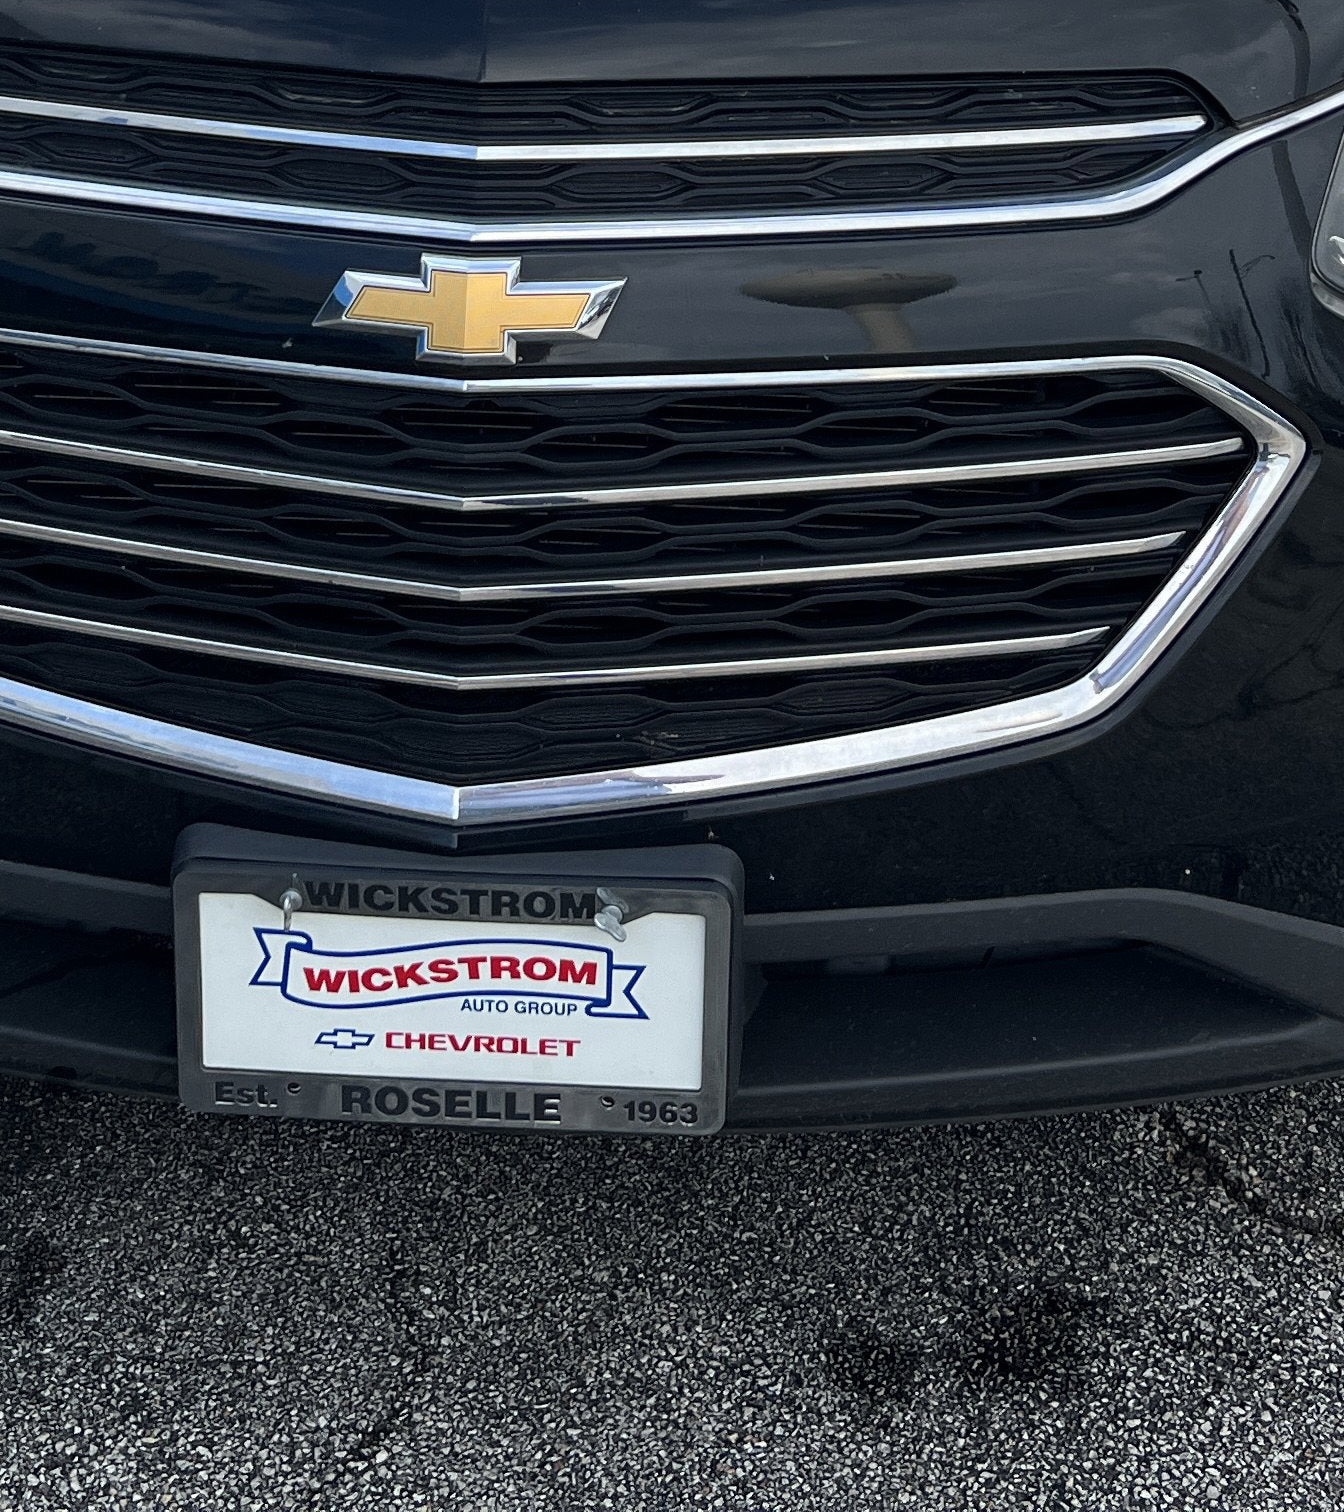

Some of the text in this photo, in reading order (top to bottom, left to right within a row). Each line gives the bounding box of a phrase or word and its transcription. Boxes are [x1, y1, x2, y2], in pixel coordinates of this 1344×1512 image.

[304, 881, 596, 920] WICKSTROM
[303, 955, 598, 994] WICKSTROM
[460, 998, 578, 1016] AUTO GROUP
[385, 1032, 581, 1057] CHEVROLET
[214, 1081, 698, 1127] Est. ROSELLE 1963
